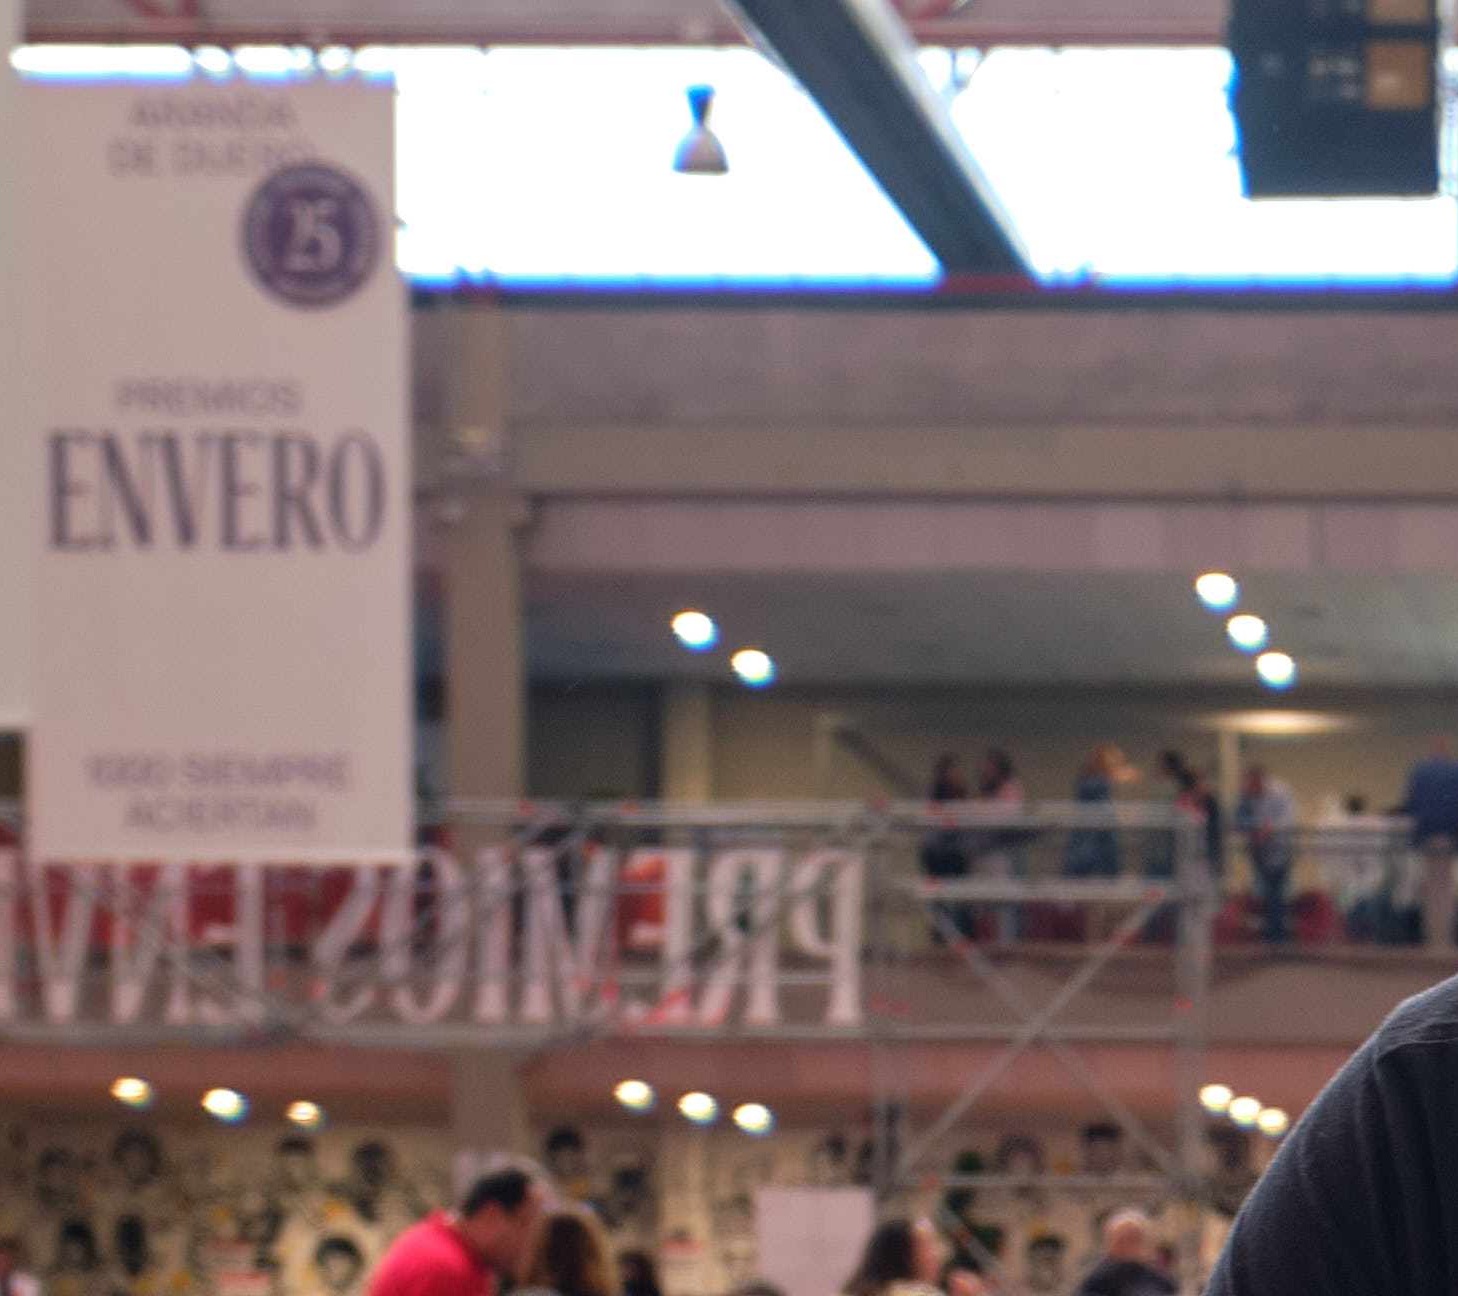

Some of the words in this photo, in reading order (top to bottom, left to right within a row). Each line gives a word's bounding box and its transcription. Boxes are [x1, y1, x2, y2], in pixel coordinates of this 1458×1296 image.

[116, 376, 300, 418] PREMIOS
[45, 428, 387, 551] ENVERO
[86, 754, 172, 790] 1000
[182, 752, 351, 793] SIEMPRE
[123, 798, 319, 834] ACIERTAN
